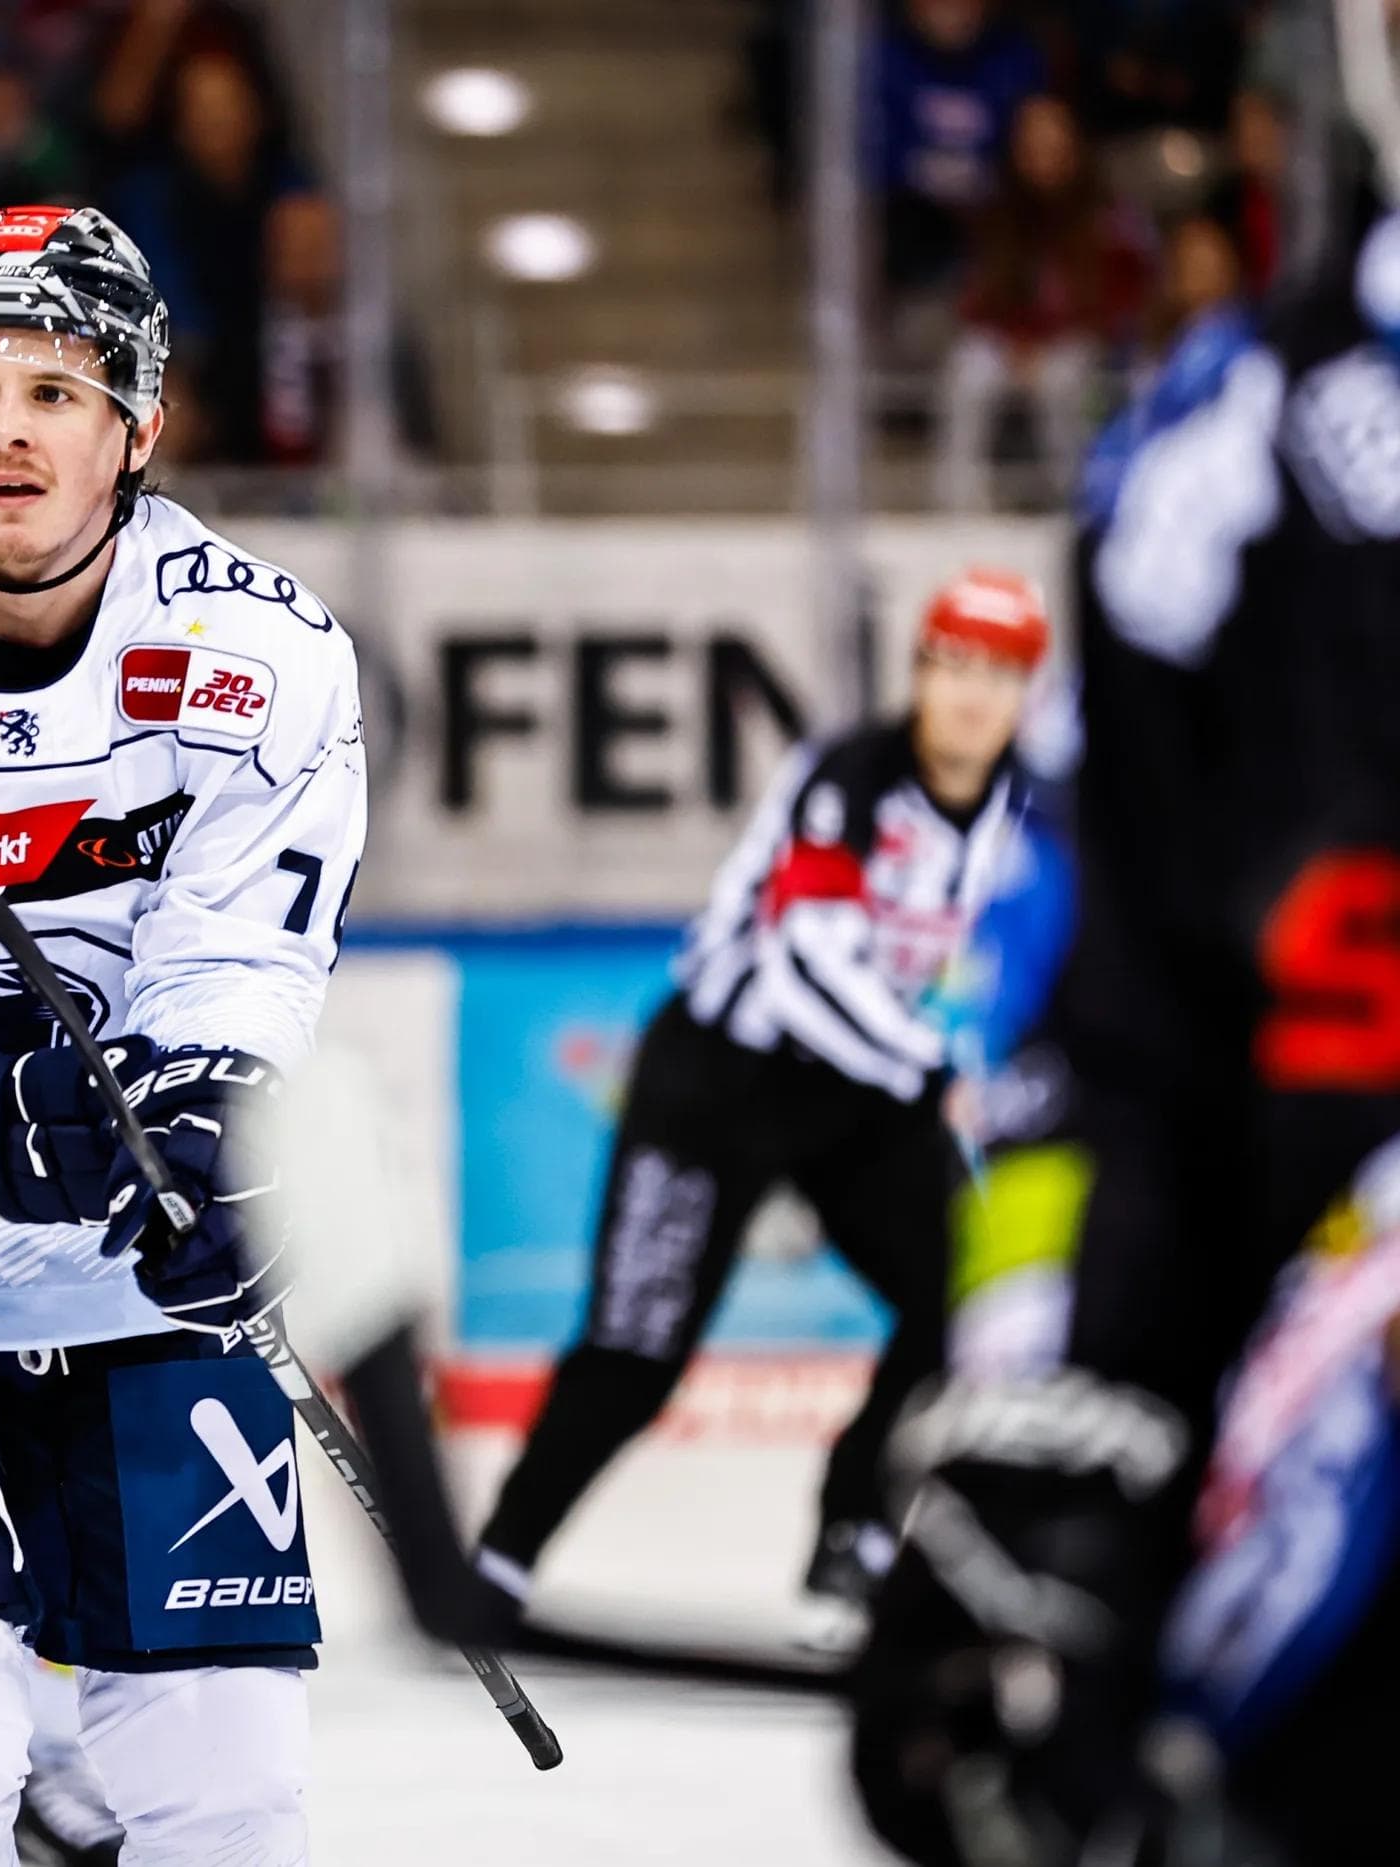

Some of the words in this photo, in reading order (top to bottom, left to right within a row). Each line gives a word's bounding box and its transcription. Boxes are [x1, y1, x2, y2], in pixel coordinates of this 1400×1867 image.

[205, 669, 253, 694] 30
[187, 688, 264, 719] DEL
[375, 628, 812, 813] FEN
[122, 1057, 268, 1109] BAU
